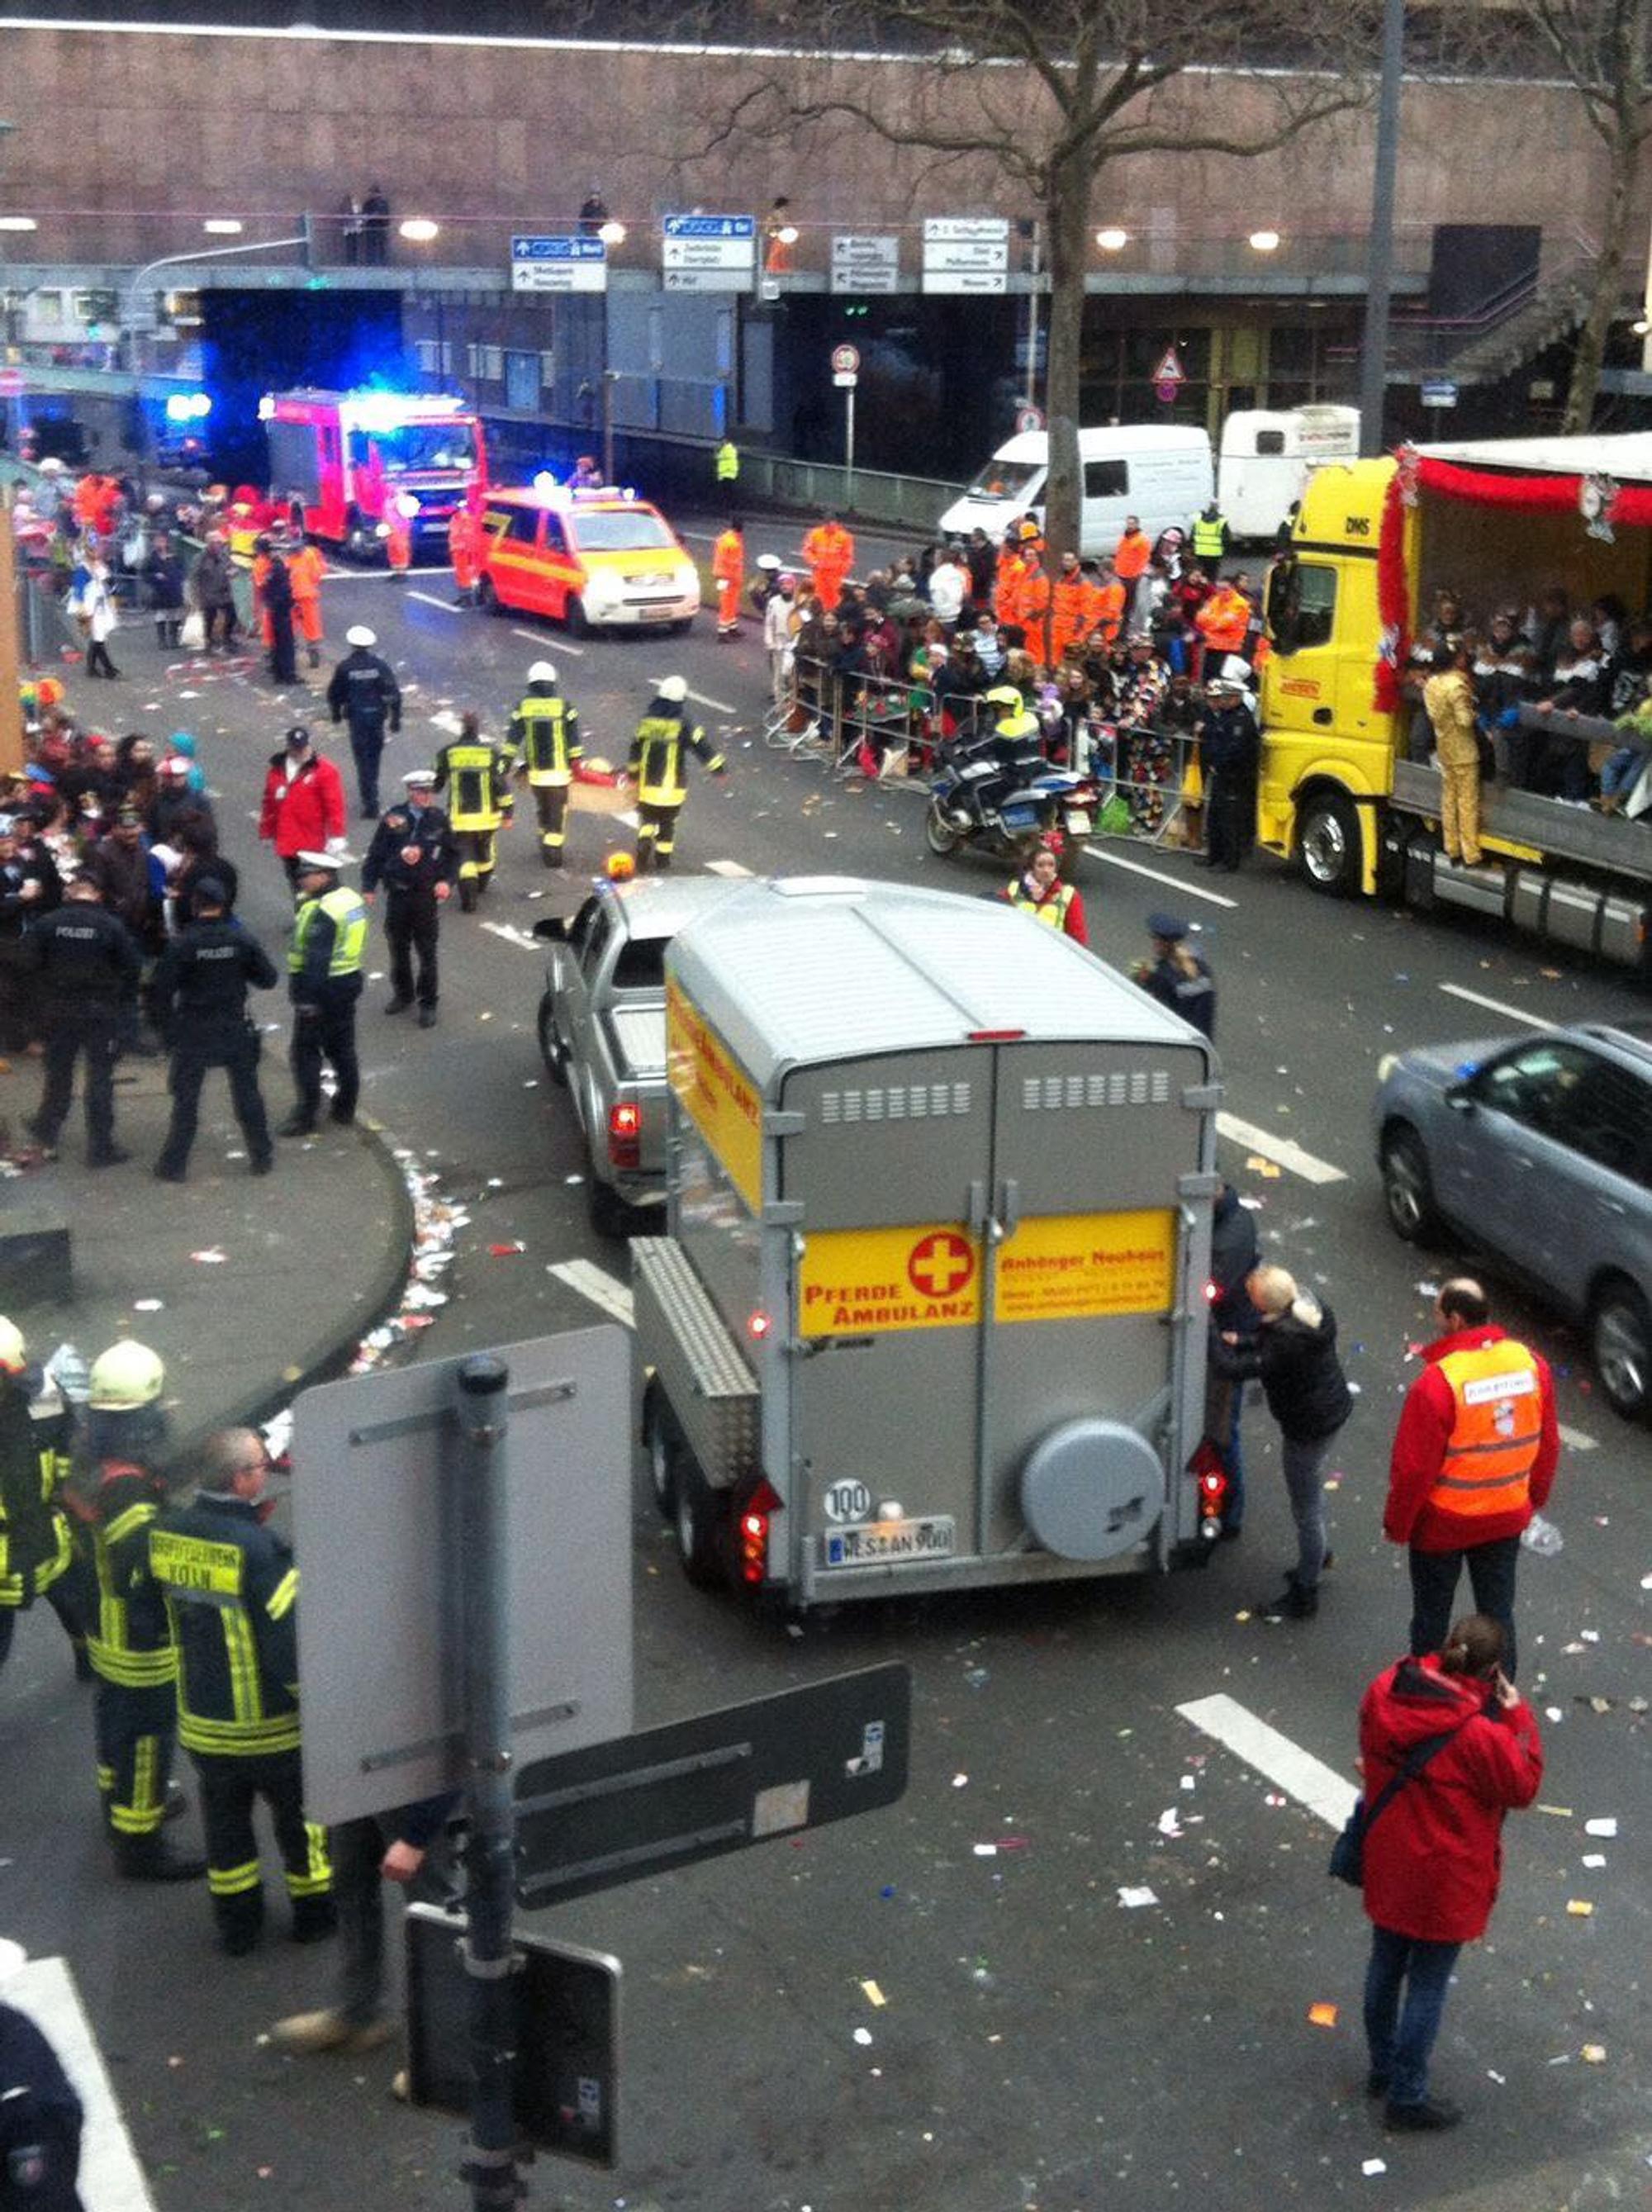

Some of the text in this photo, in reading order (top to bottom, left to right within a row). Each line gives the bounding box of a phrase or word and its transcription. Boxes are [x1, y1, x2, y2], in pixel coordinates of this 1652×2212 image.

[55, 926, 95, 939] POLIZEI
[197, 947, 235, 959] POLIZEI
[831, 1485, 866, 1516] 100
